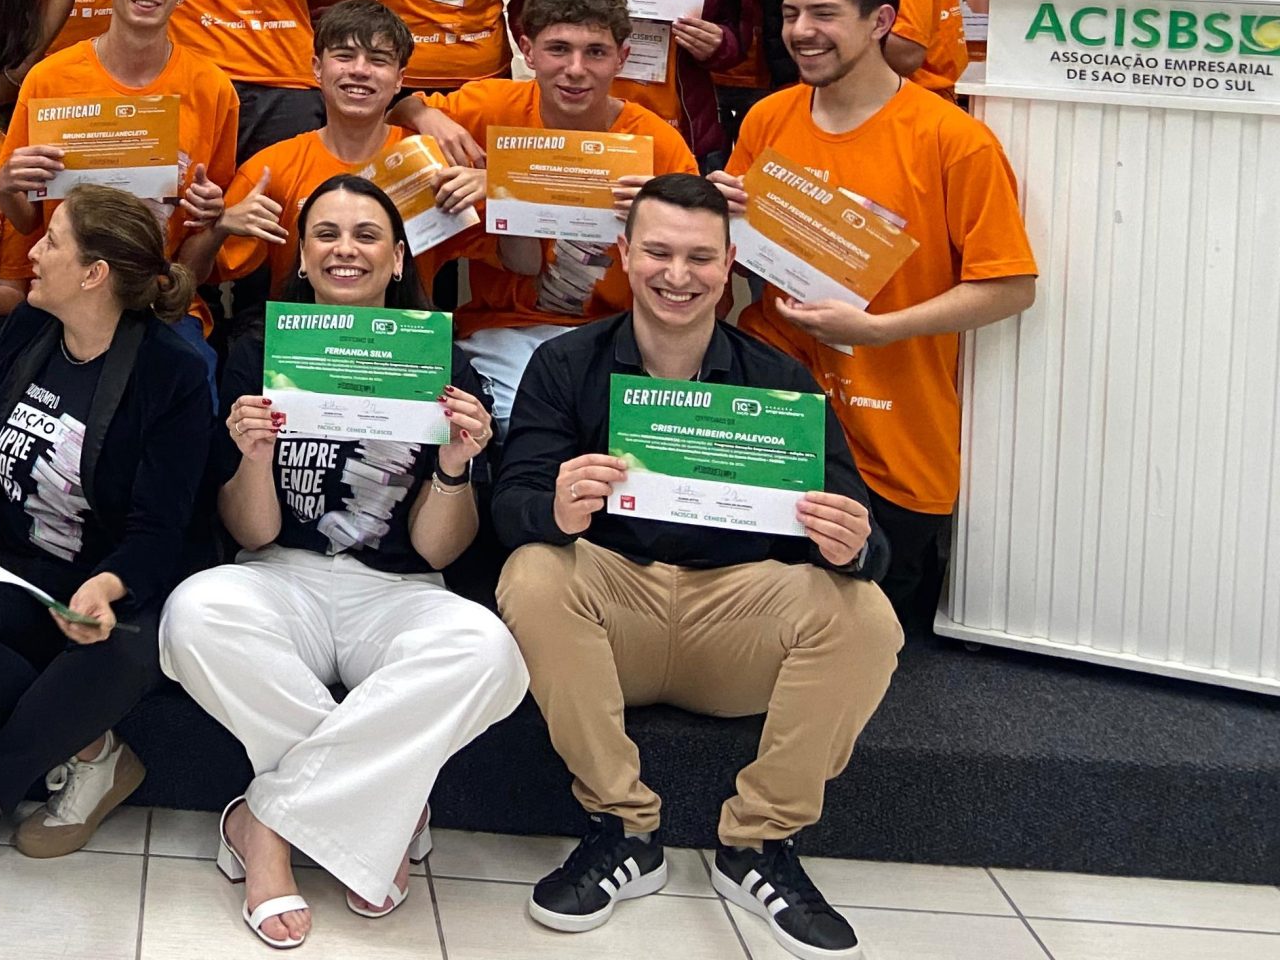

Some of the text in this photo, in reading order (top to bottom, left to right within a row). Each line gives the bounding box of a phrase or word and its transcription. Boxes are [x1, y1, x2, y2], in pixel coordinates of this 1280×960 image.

[1025, 3, 1234, 53] ACISBS
[1050, 51, 1273, 76] ASSOCIAÇÃO EMPRESARIAL
[1067, 68, 1086, 81] DE
[1132, 73, 1186, 87] BENTO
[1193, 77, 1219, 89] DO
[1225, 79, 1255, 92] SUL
[37, 103, 101, 122] CERTIFICADO
[496, 136, 565, 150] CERTIFICADO
[762, 161, 834, 205] CERTIFICADO
[277, 314, 354, 331] CERTIFICADO
[325, 347, 393, 359] FERNANDA SILVA
[623, 389, 712, 408] CERTIFICADO
[651, 423, 785, 446] CRISTIAN RIBEIRO PALEVODA
[278, 441, 340, 469] EMPRE
[281, 469, 325, 493] ENDE
